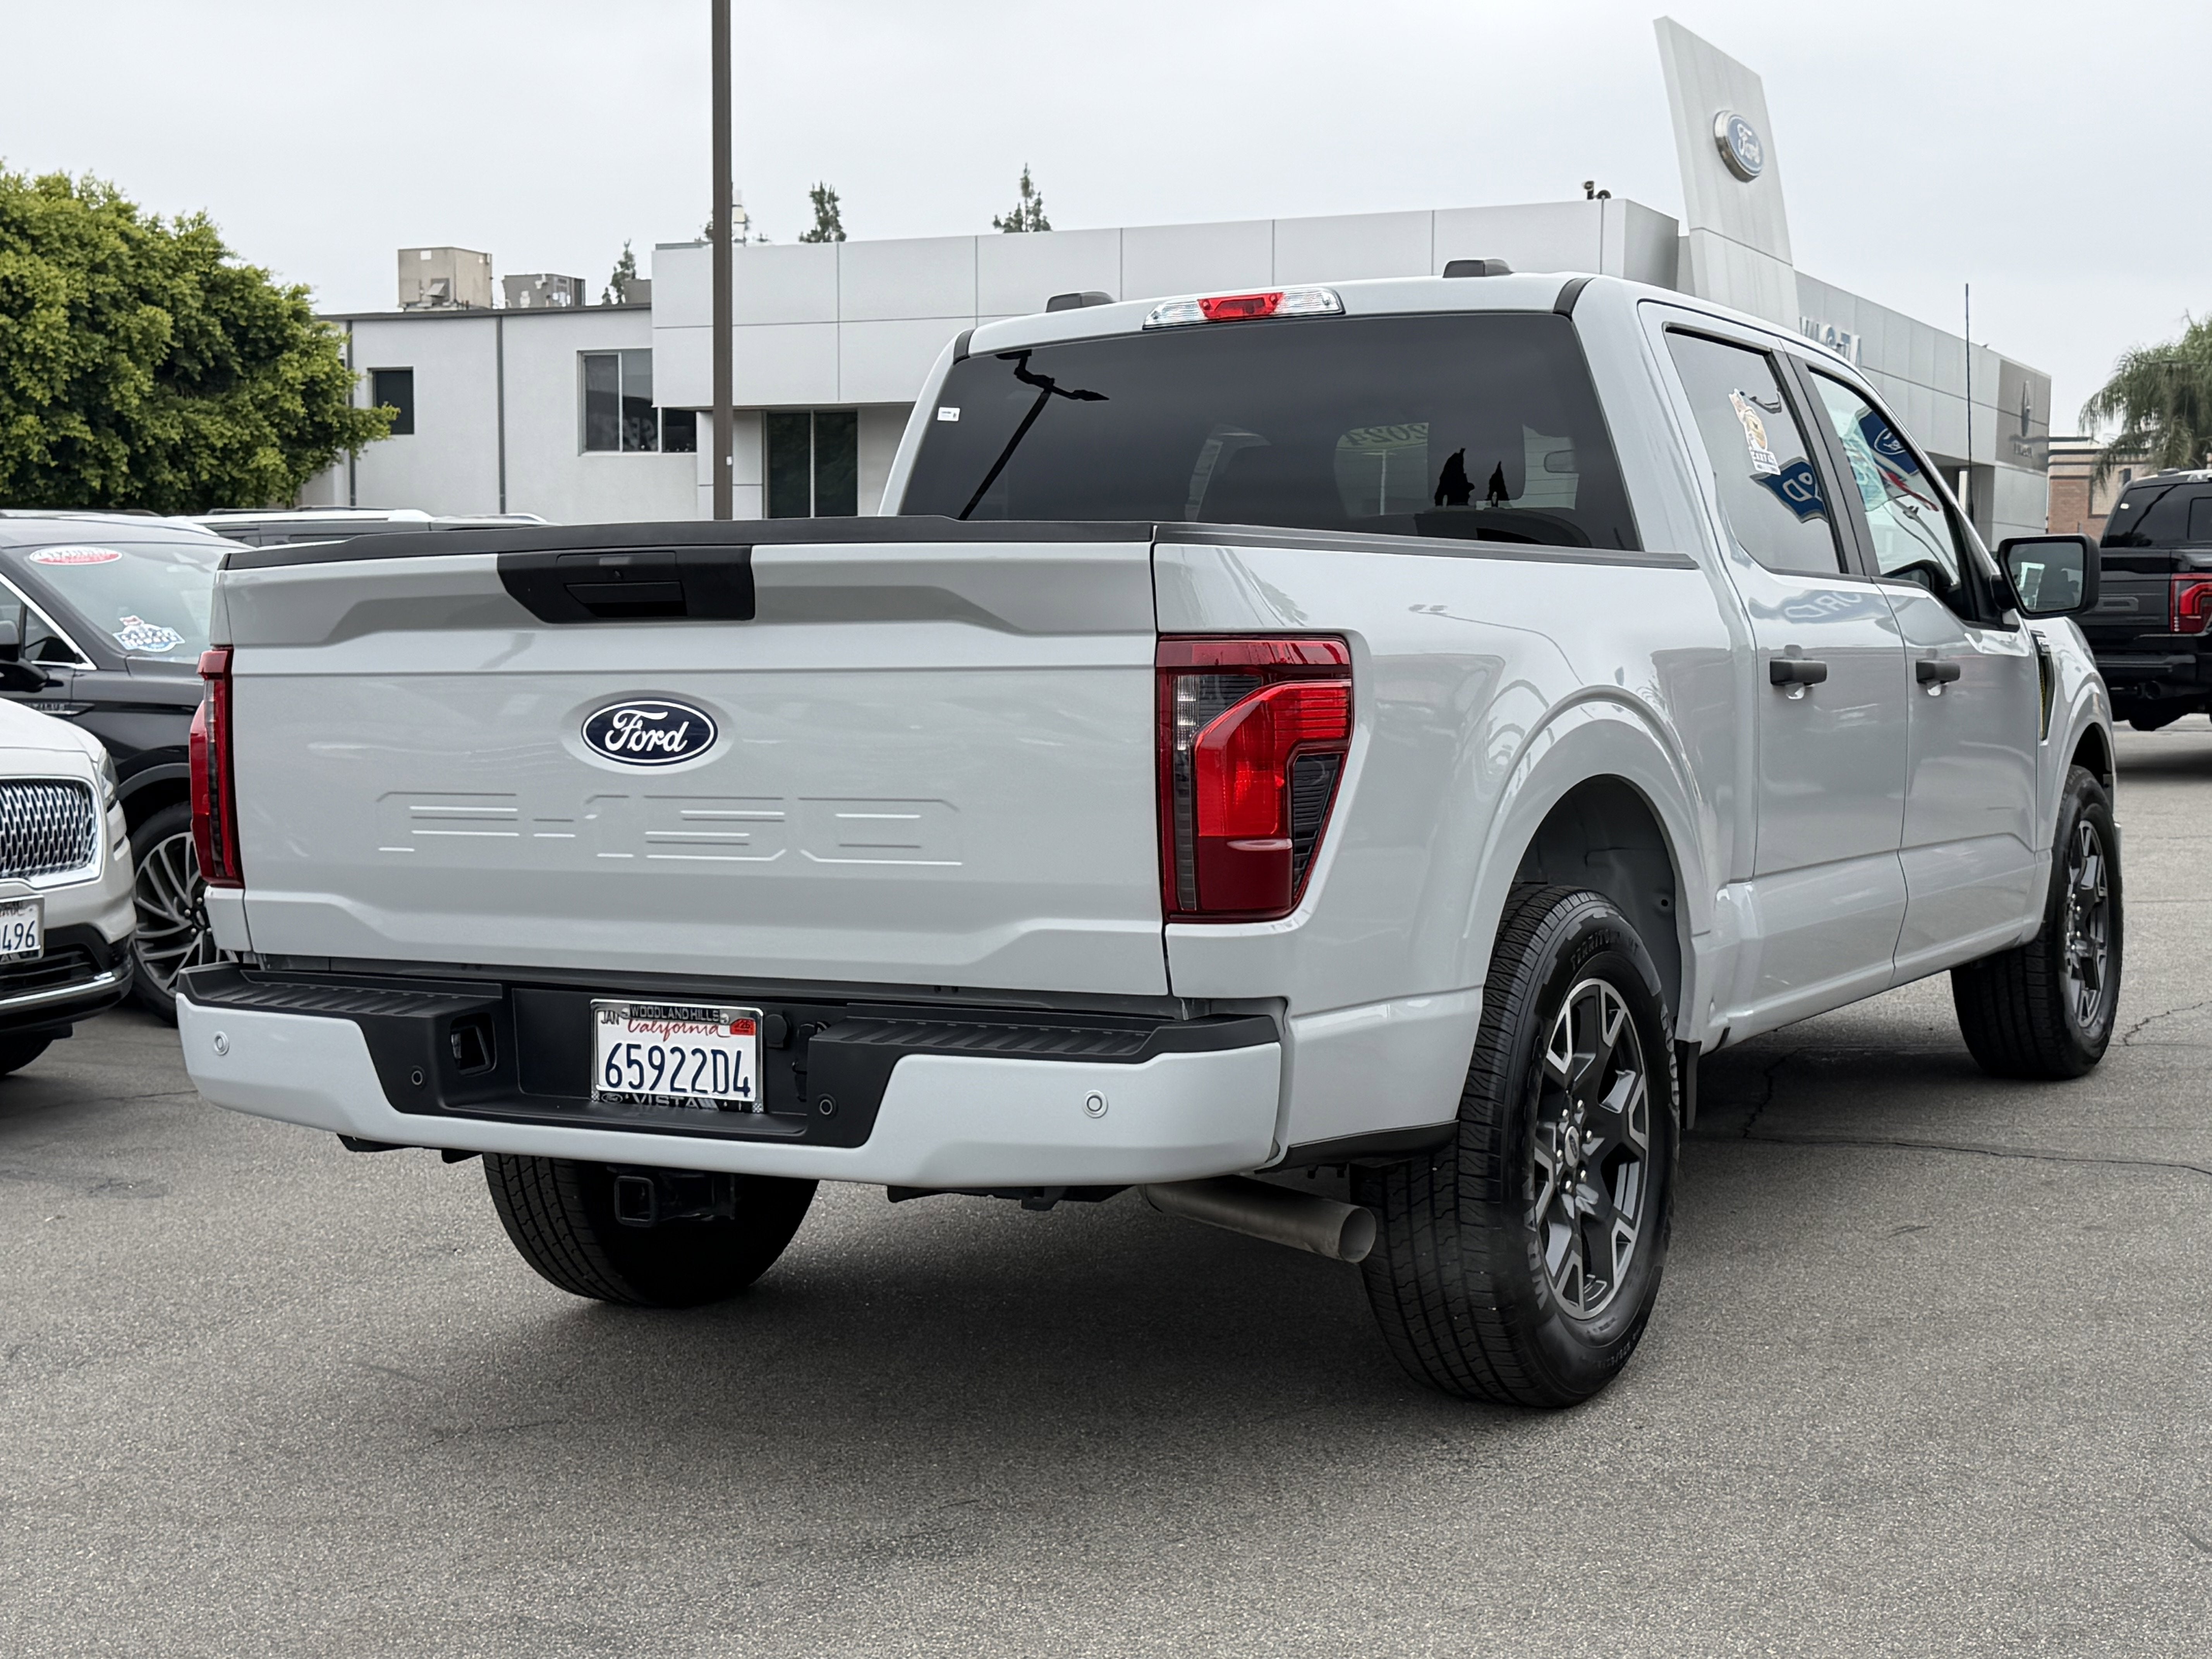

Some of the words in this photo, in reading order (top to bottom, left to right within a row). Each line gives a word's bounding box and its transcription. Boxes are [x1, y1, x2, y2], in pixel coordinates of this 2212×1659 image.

[1737, 123, 1761, 164] Ford
[605, 709, 689, 752] Ford
[376, 791, 963, 867] F-150
[3, 920, 35, 950] 496
[601, 1010, 619, 1025] JAN
[631, 1005, 689, 1020] WOODLAND
[691, 1009, 719, 1022] HILLS
[628, 1018, 731, 1042] California
[605, 1042, 750, 1097] 65922D4
[632, 1093, 698, 1108] VISTA
